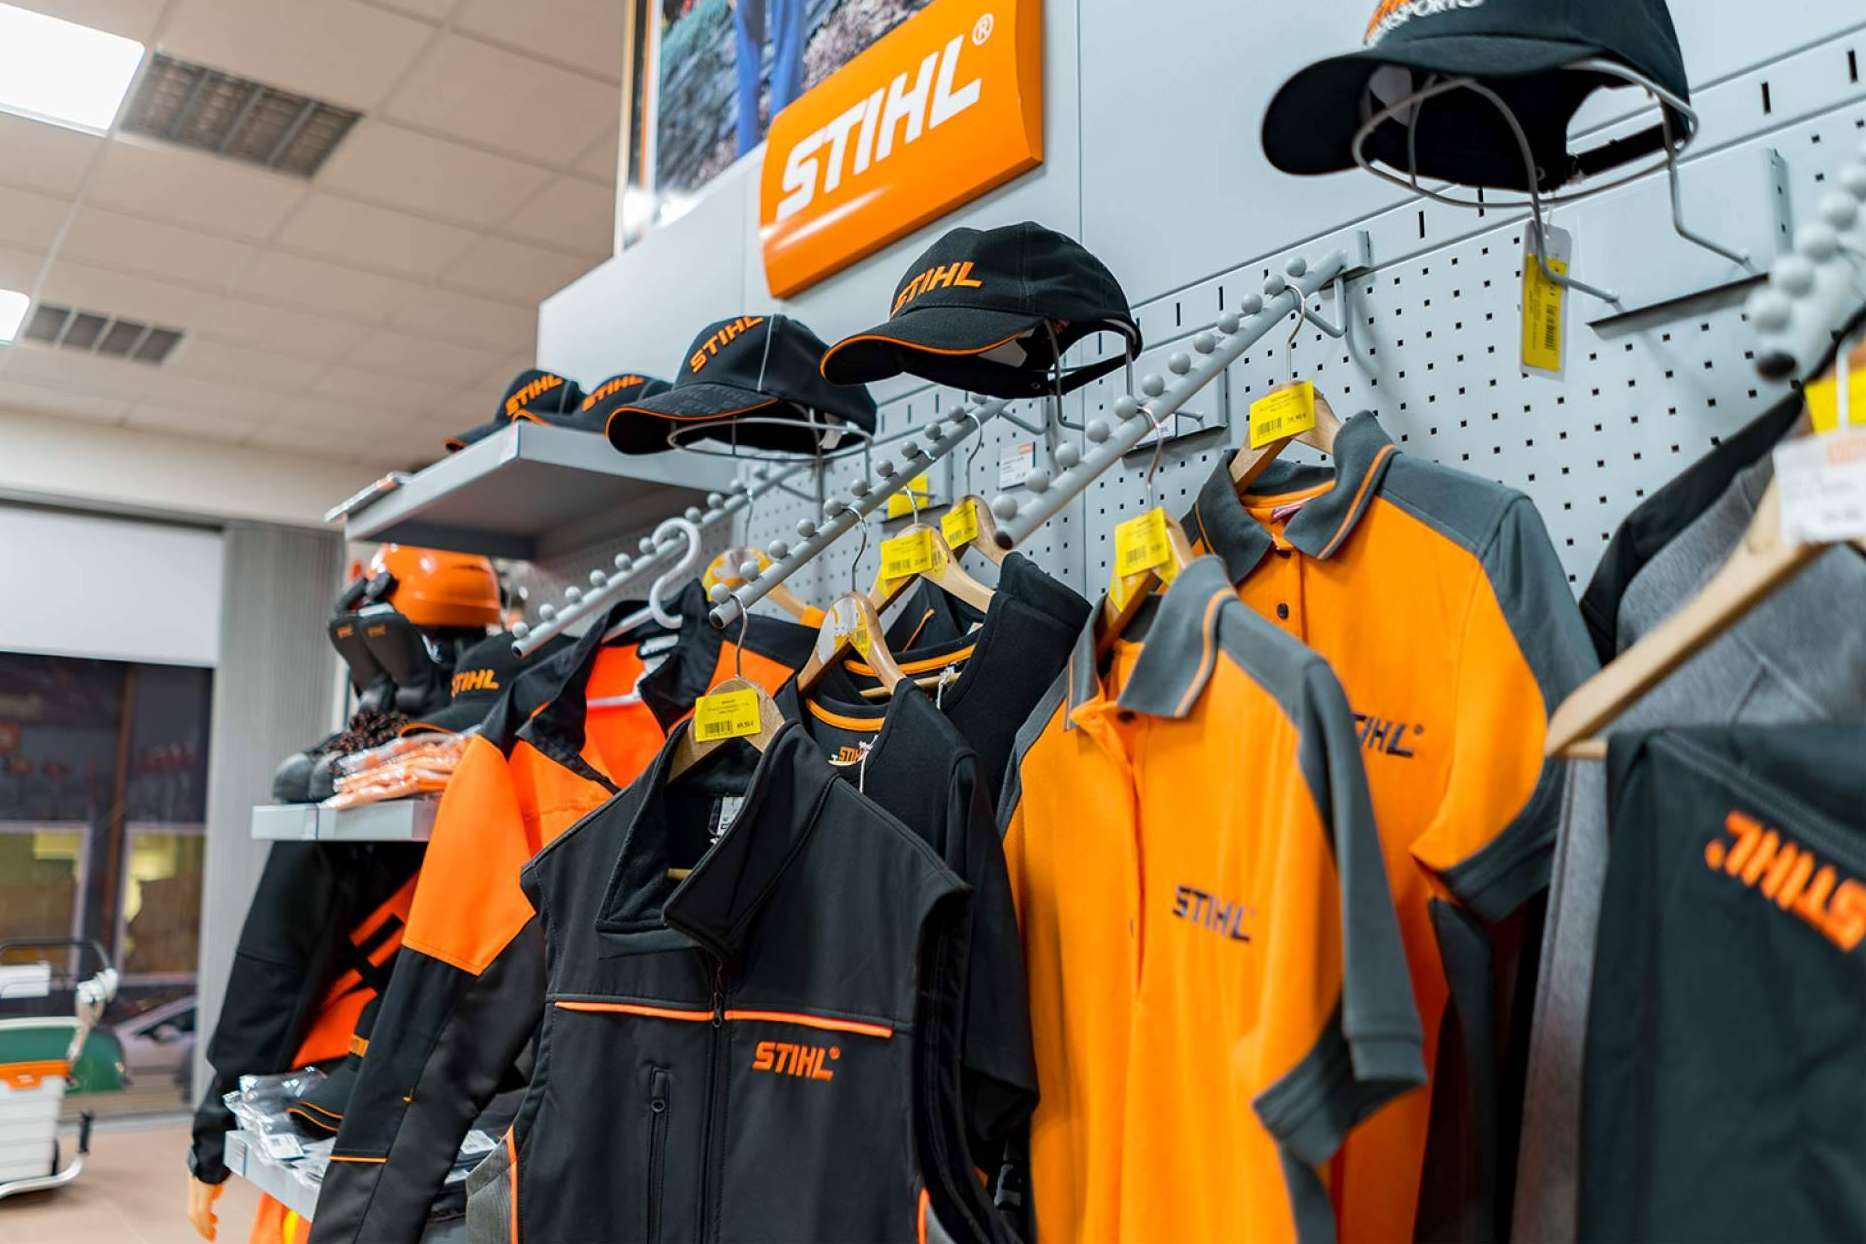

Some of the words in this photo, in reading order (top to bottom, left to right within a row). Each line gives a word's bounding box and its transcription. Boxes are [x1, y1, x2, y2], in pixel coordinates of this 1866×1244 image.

[888, 260, 983, 316] STIHL
[690, 315, 764, 373] STIHL
[505, 374, 563, 416] STIHL
[581, 374, 645, 412] STIHL
[1172, 885, 1251, 941] STIHL
[752, 1041, 834, 1080] STIHL
